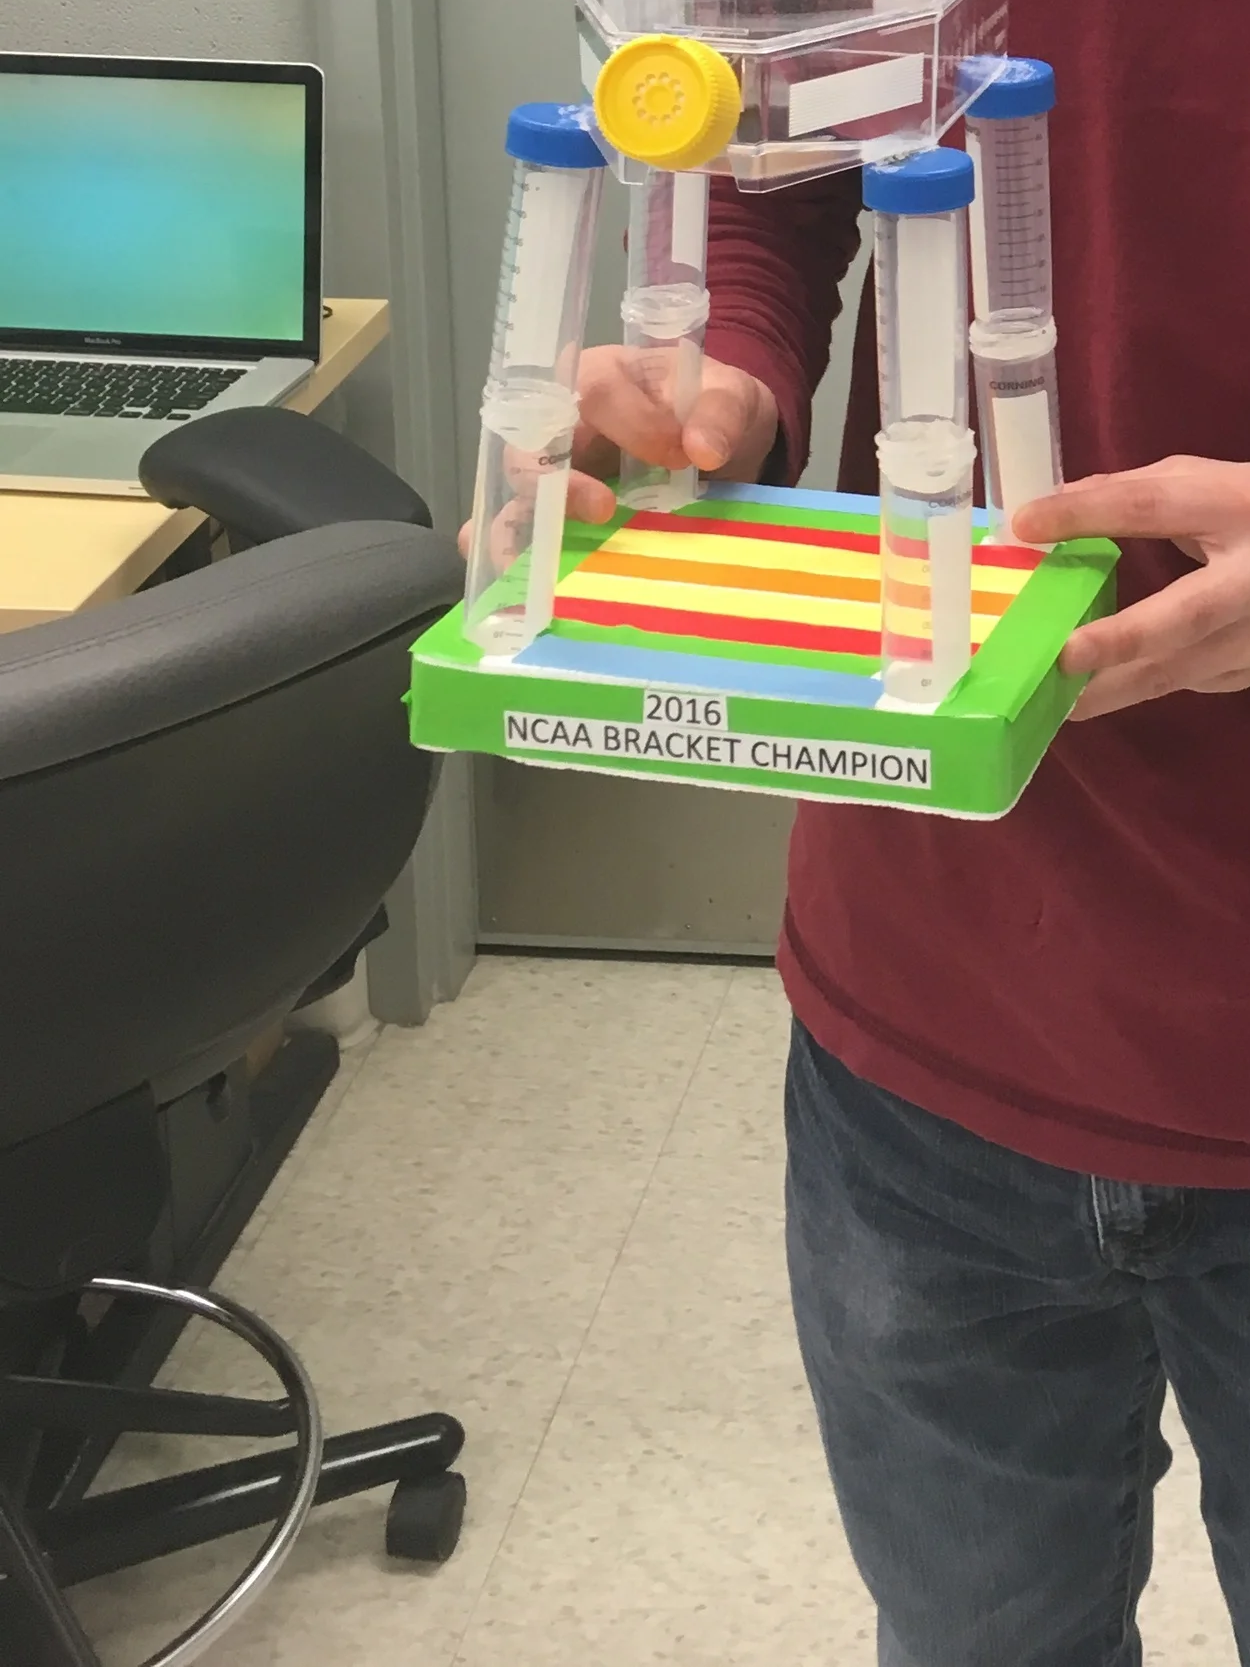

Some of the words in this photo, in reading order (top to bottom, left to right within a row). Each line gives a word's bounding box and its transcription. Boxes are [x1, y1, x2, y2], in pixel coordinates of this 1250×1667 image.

[988, 375, 1046, 392] CORNING
[646, 693, 723, 727] 2016
[506, 714, 593, 749] NCAA
[603, 724, 742, 764] BRACKET
[750, 740, 928, 785] CHAMPION
